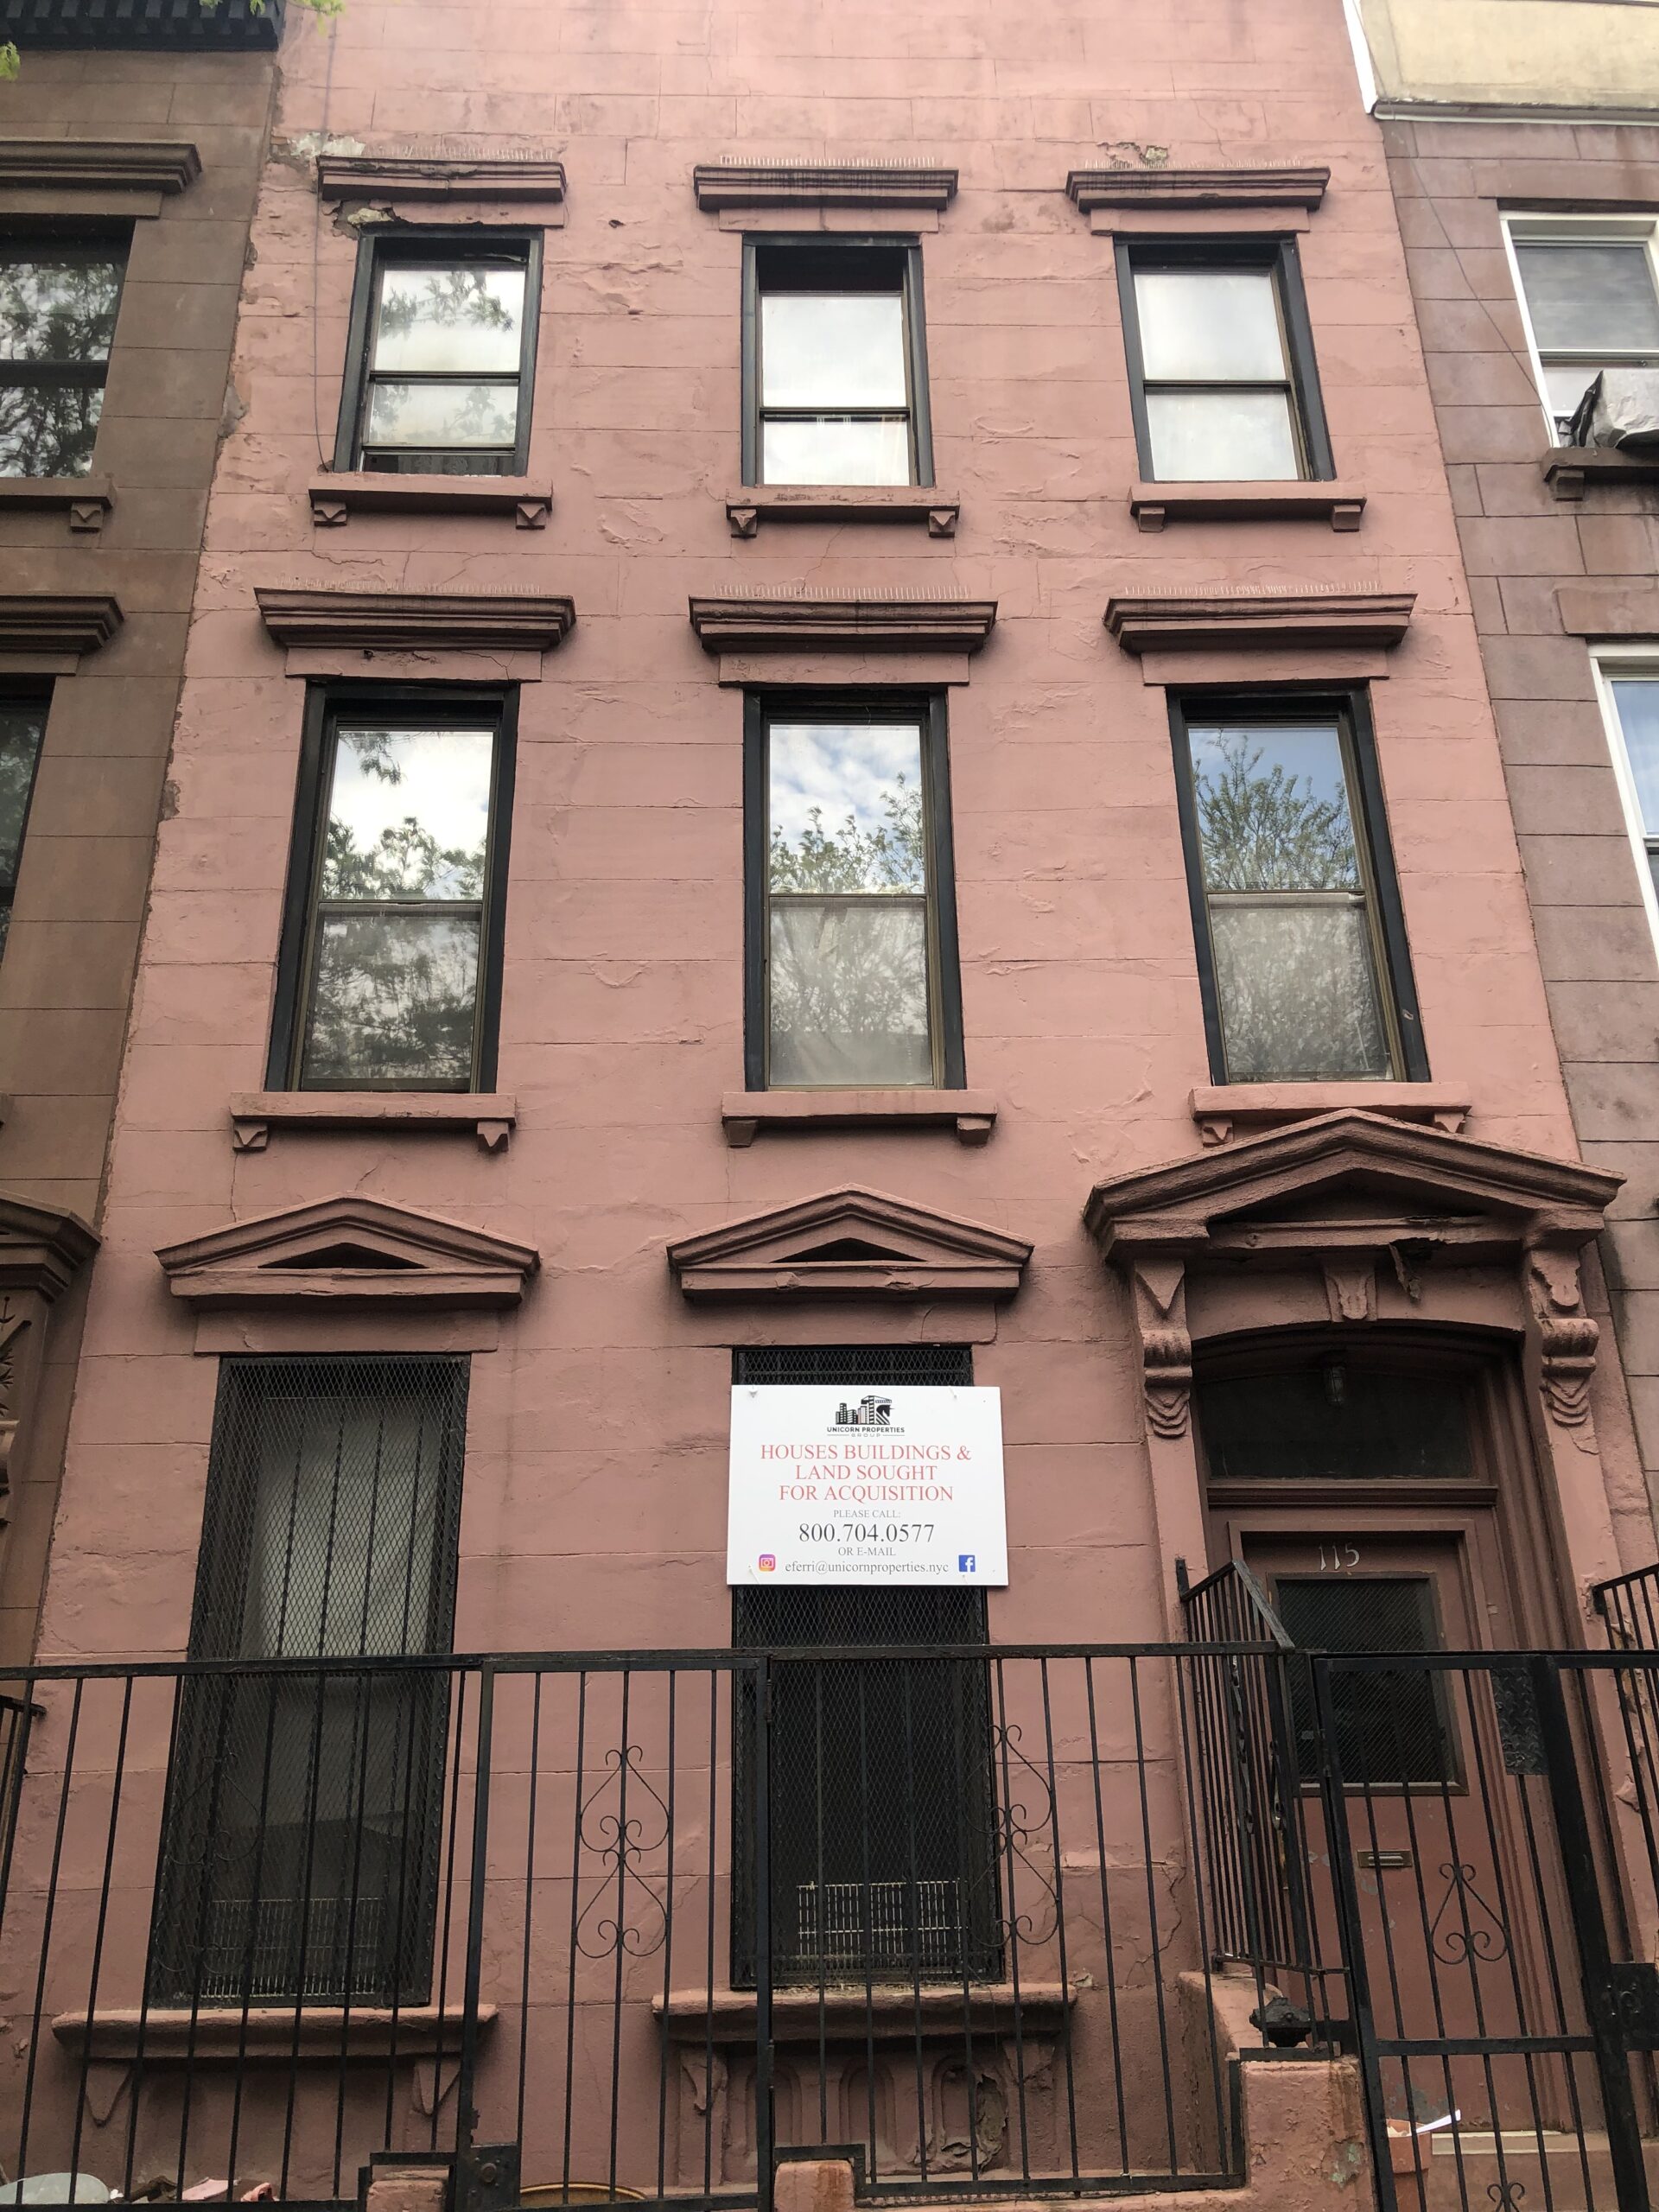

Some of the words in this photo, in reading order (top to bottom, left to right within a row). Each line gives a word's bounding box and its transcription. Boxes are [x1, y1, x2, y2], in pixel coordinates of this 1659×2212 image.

[761, 1445, 837, 1459] HOUSES
[844, 1446, 950, 1460] BUILDINGS
[957, 1446, 972, 1460] &
[795, 1465, 851, 1480] LAND
[856, 1465, 938, 1480] SOUGHT
[779, 1485, 818, 1501] FOR
[824, 1485, 953, 1503] ACQUISITION
[834, 1510, 870, 1518] PLEASE
[873, 1510, 900, 1518] CALL:
[799, 1523, 935, 1542] 800.704.0577
[838, 1547, 855, 1556] OR
[857, 1547, 896, 1556] E-MAIL
[1319, 1542, 1361, 1571] 115
[785, 1560, 949, 1575] eferri@unicornproperties.nyc
